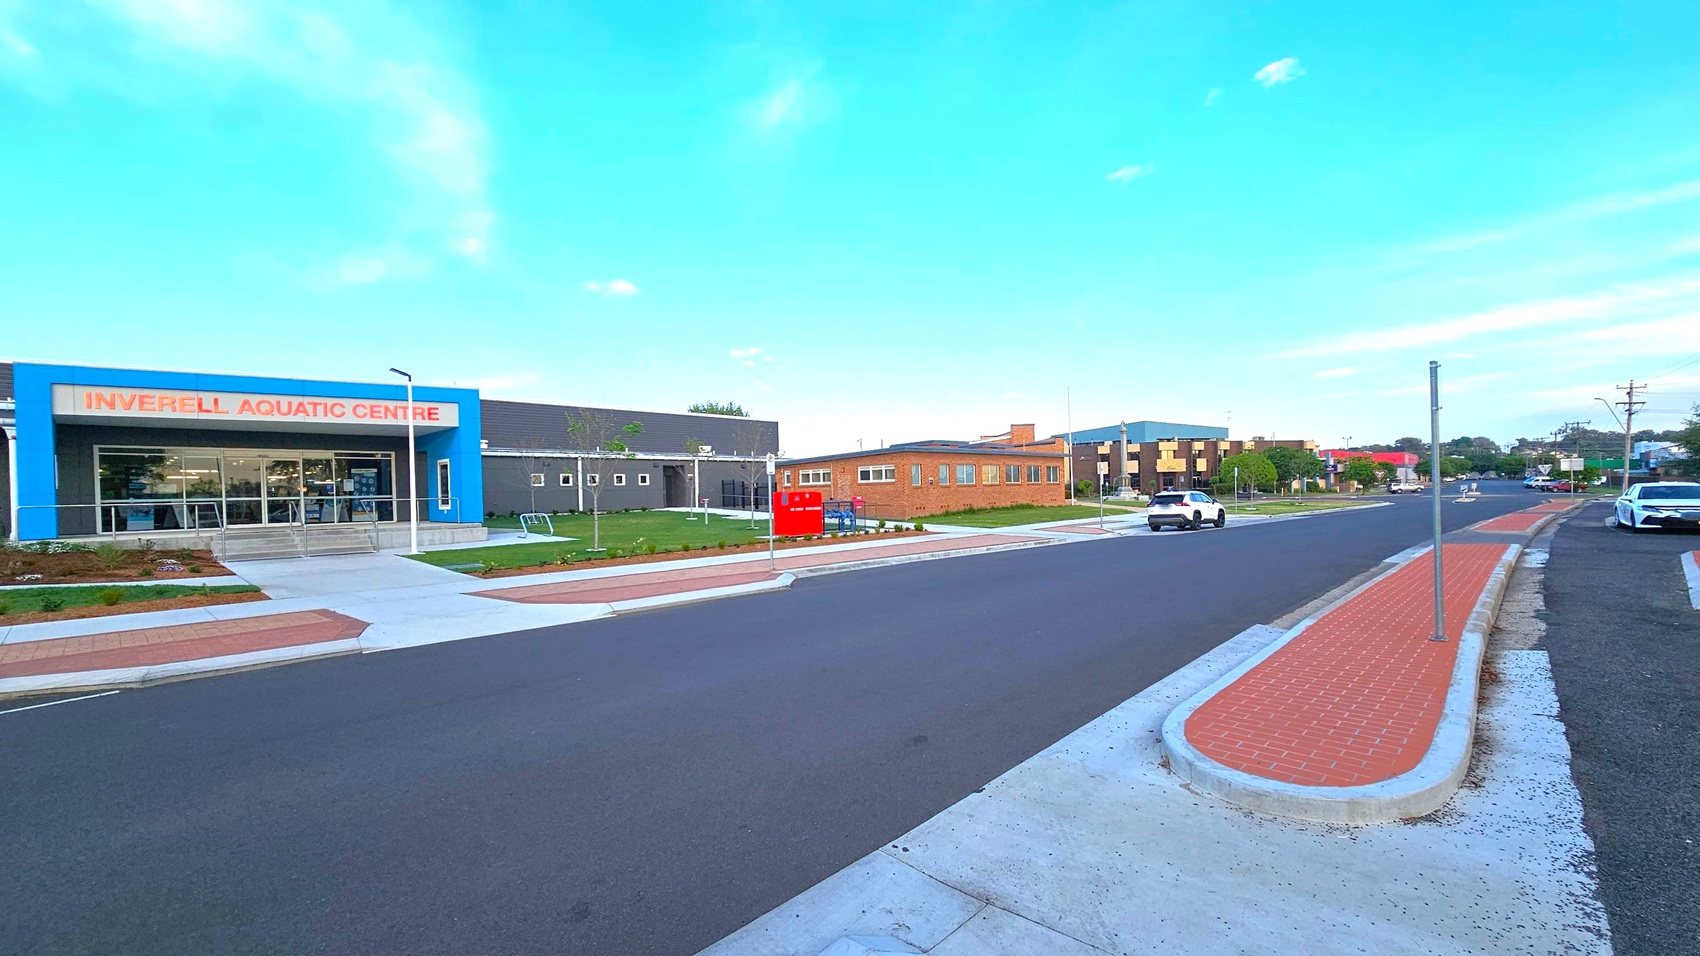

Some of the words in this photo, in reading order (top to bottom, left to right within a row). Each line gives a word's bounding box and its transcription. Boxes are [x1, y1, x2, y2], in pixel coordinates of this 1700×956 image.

[84, 391, 229, 414] INVERELL
[236, 398, 346, 418] AQUATIC
[352, 403, 440, 421] CENTRE
